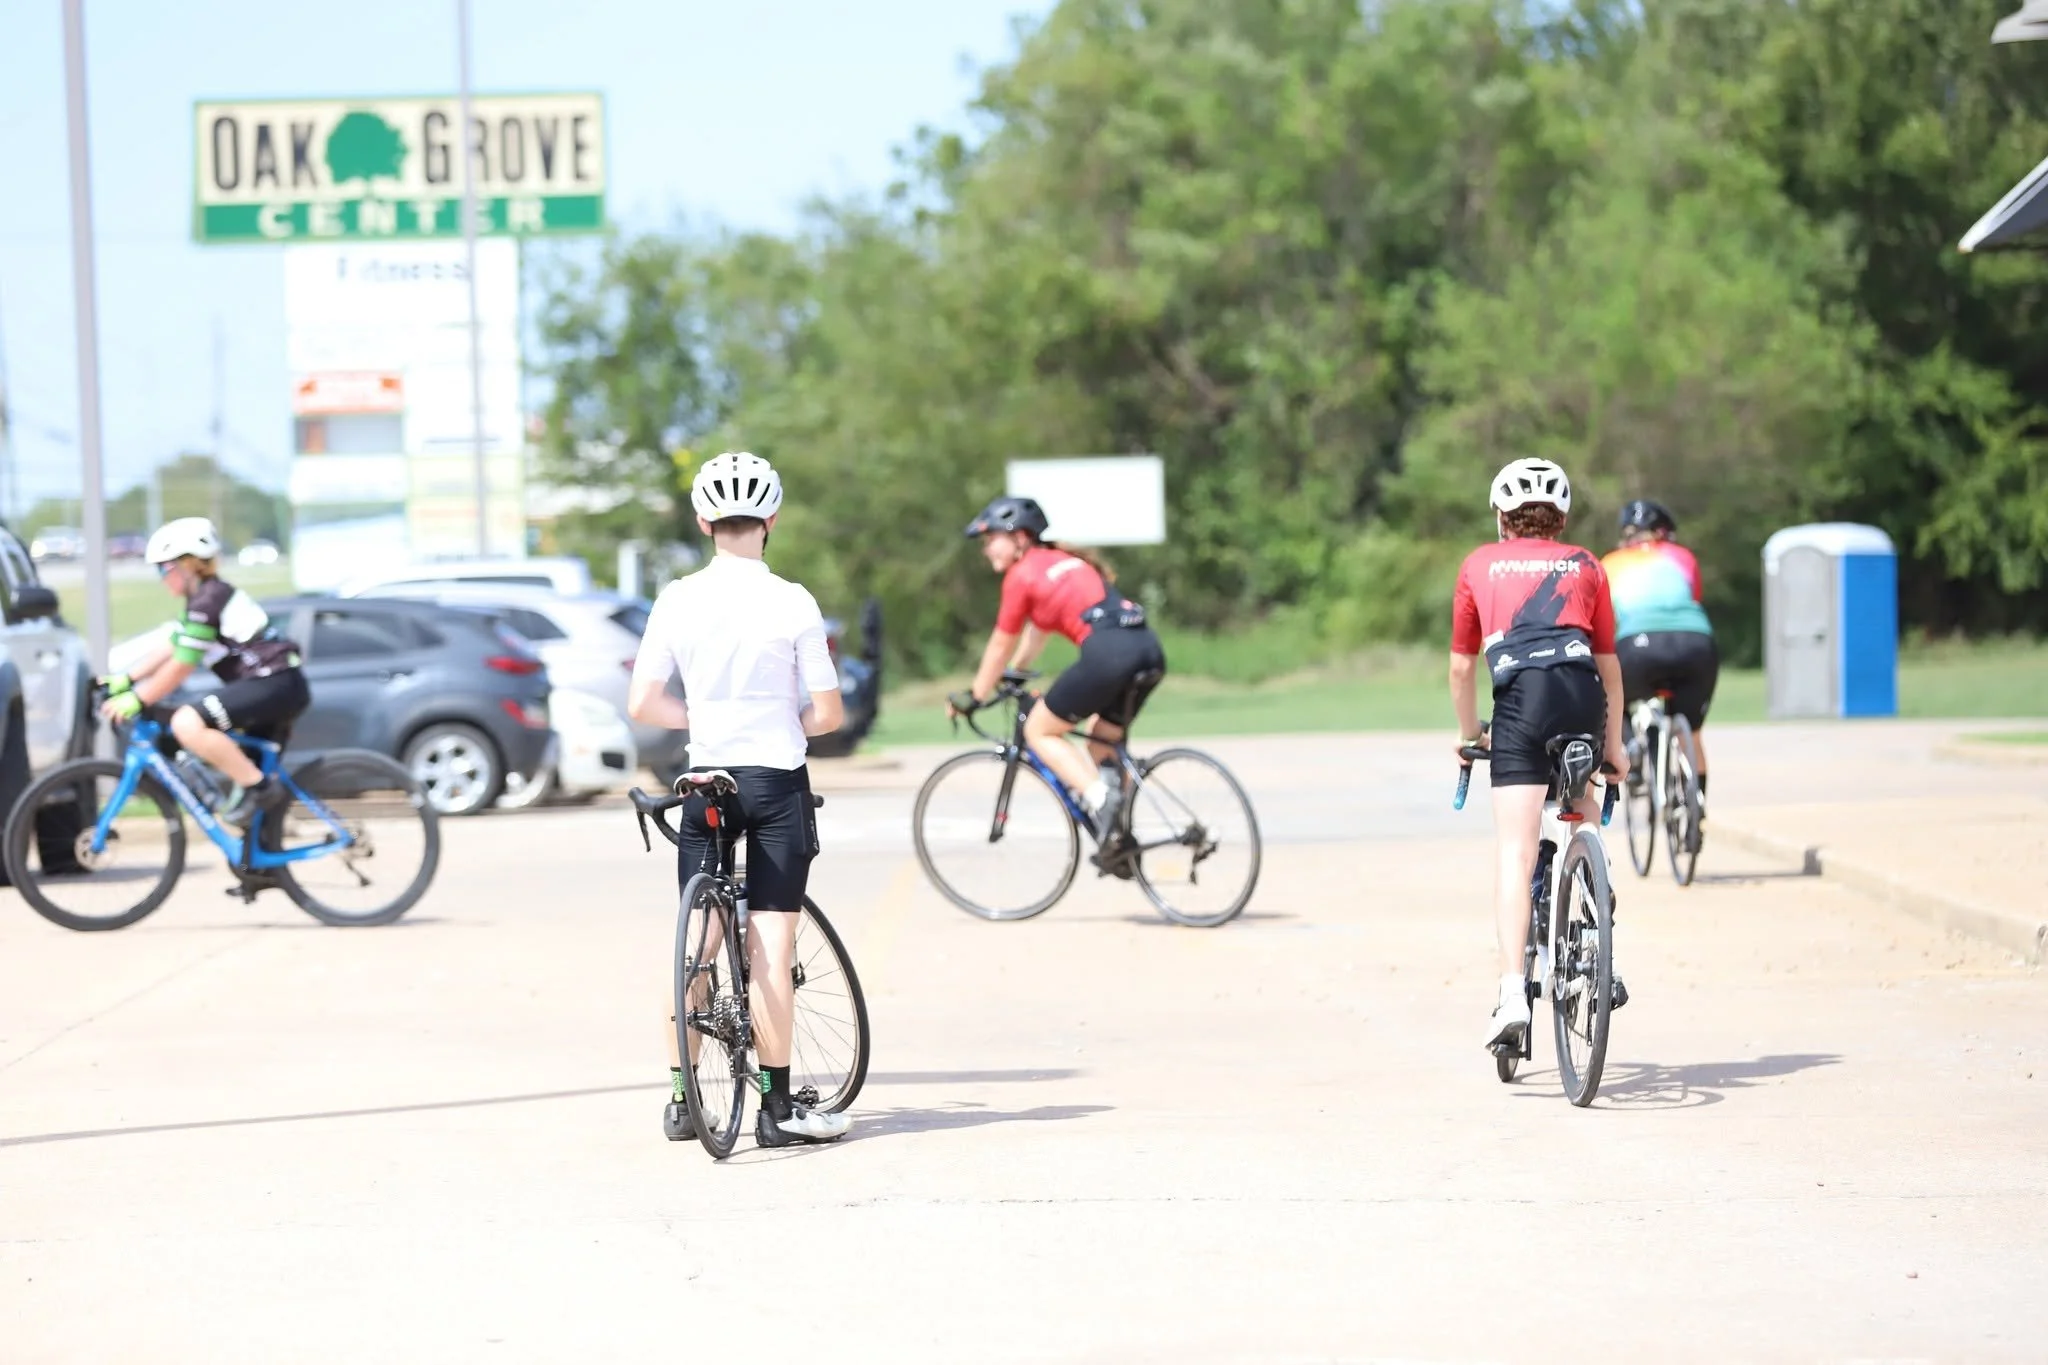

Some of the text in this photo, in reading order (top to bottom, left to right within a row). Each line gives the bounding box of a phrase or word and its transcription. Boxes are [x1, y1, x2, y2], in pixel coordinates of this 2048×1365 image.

[212, 111, 590, 191] OAK GROVE
[256, 198, 546, 240] CENTER
[1488, 559, 1581, 577] MAVERICK
